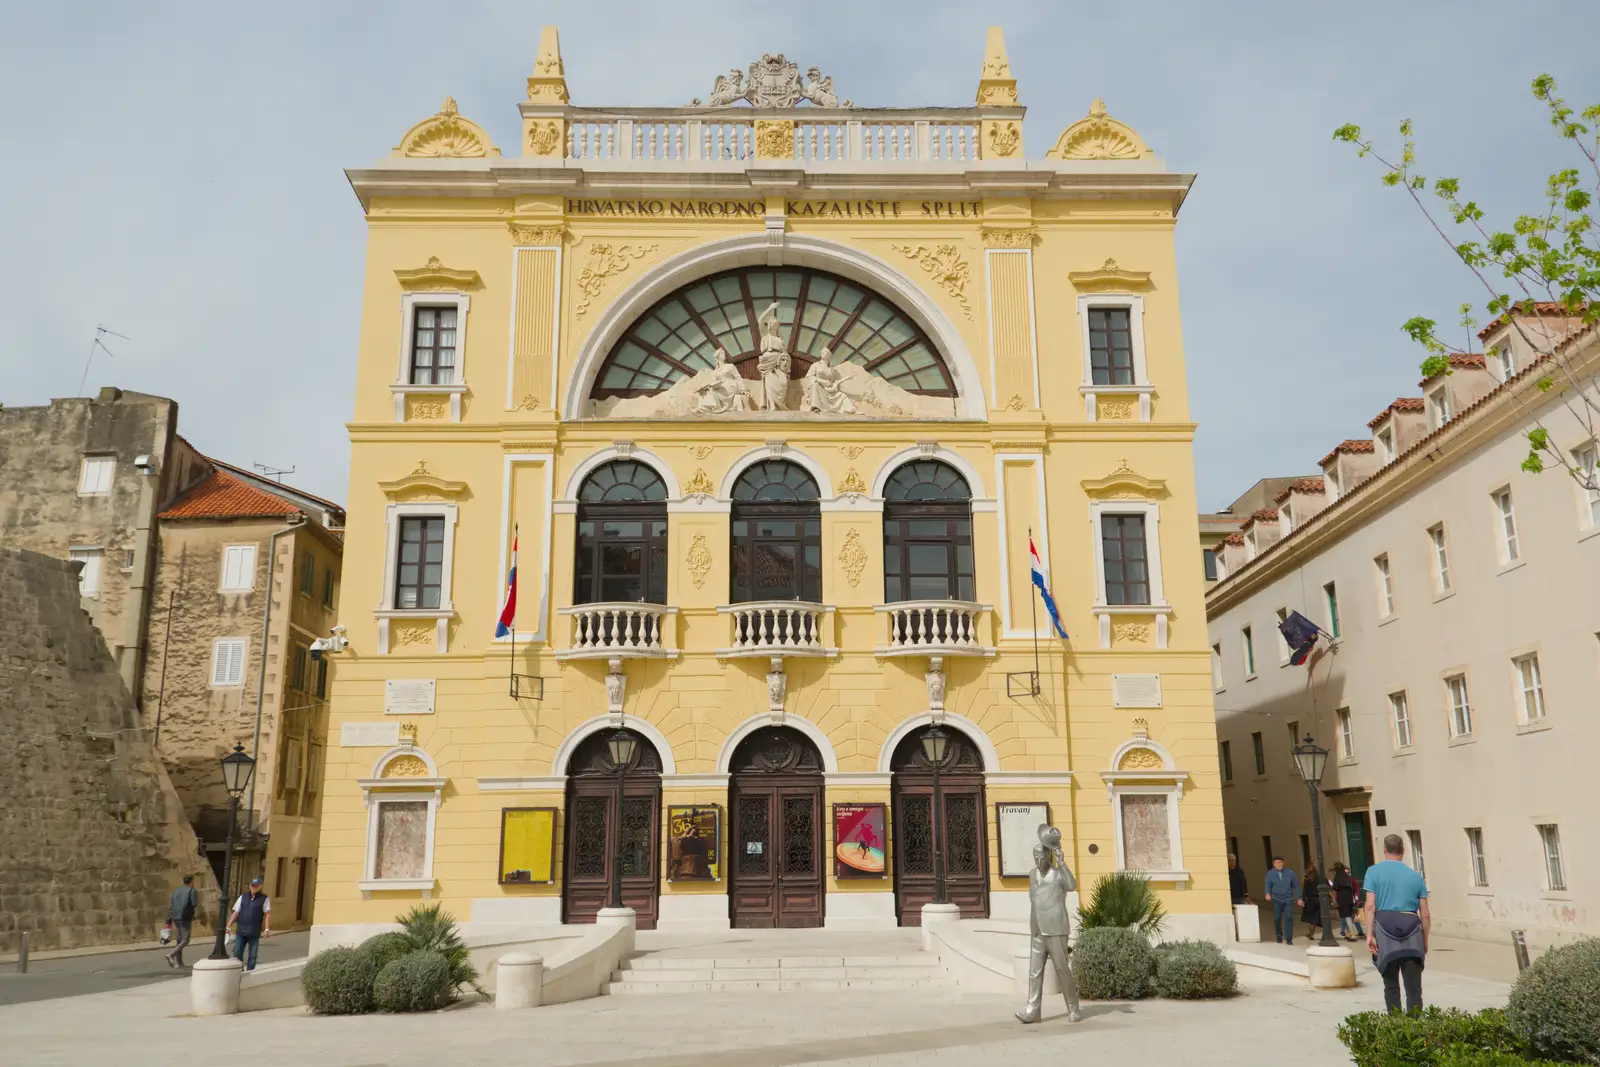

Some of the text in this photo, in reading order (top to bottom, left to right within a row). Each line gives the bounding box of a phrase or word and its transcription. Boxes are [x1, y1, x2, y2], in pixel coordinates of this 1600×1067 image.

[568, 199, 982, 215] HRVATSKO NARODNO KAZALIŠTE SPLIT
[1001, 805, 1030, 815] Travanj
